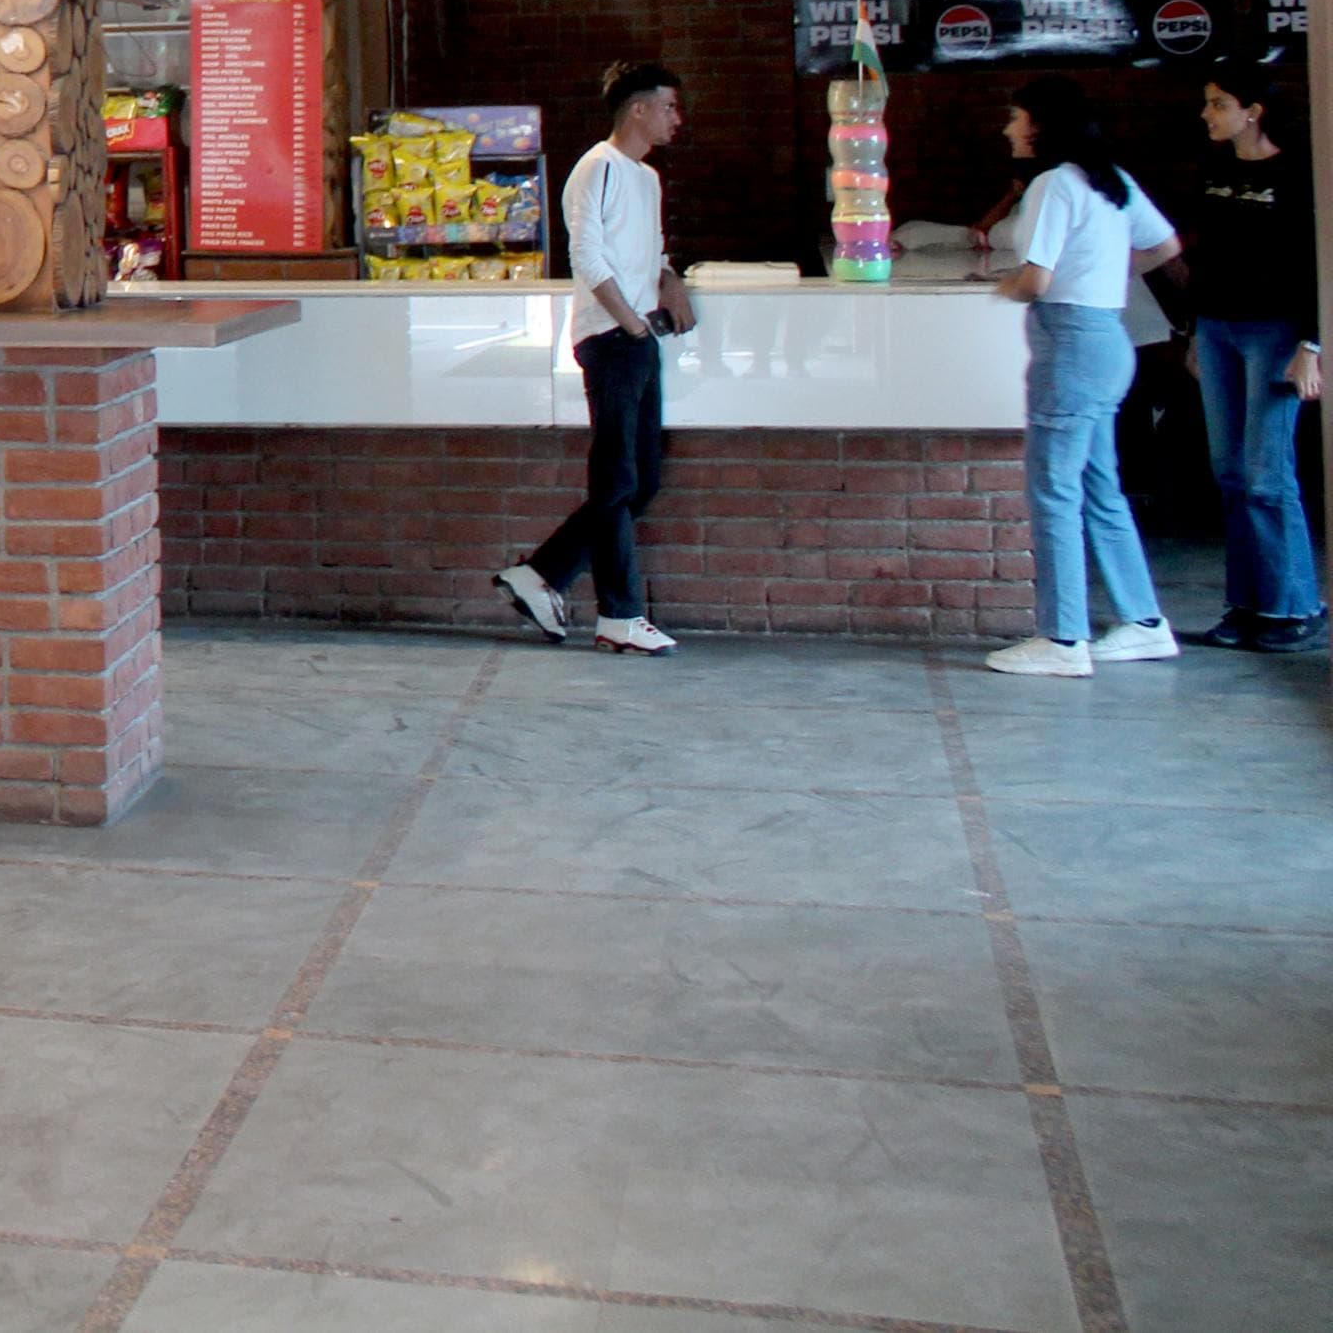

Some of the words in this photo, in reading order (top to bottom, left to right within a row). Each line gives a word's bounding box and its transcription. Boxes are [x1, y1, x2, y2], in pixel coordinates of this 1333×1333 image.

[810, 0, 889, 23] WITH
[810, 24, 903, 46] PESI
[939, 25, 989, 38] PEPSI
[1156, 21, 1209, 33] PEPSI
